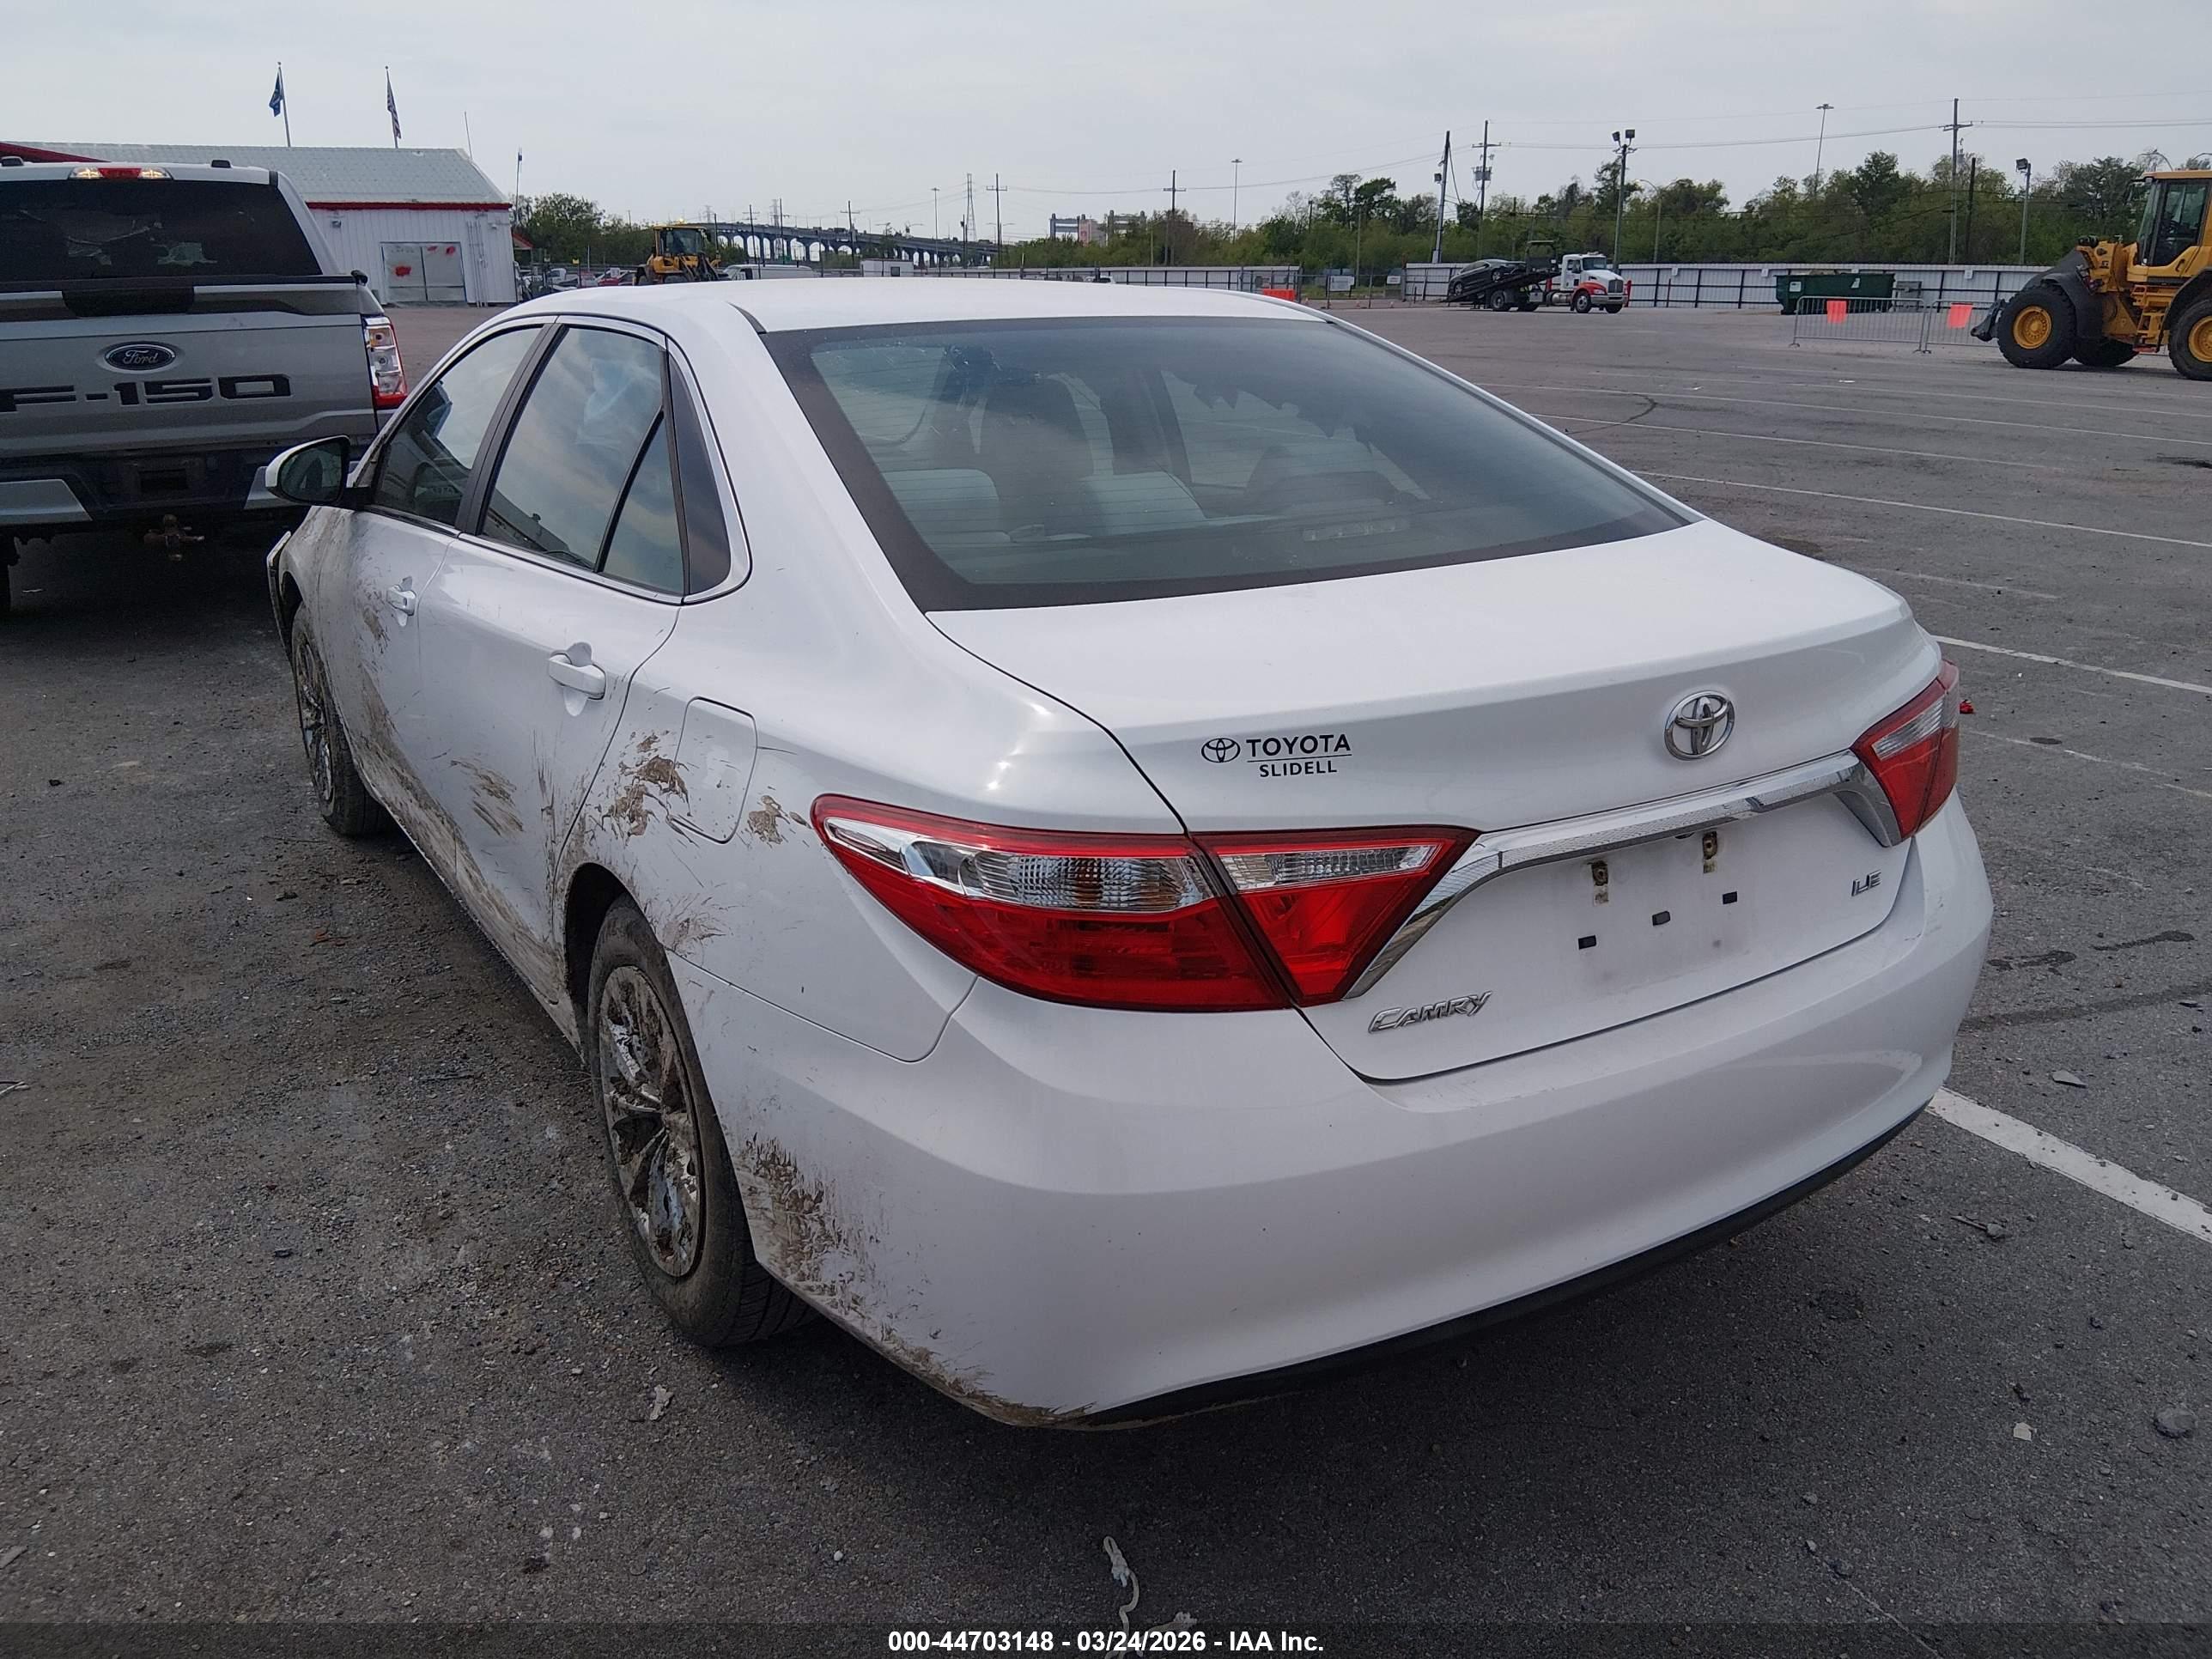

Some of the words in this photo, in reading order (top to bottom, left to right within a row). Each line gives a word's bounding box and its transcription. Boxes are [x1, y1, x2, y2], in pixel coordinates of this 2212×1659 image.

[123, 349, 158, 364] Ford
[0, 374, 292, 413] F-150
[1246, 734, 1351, 757] TOYOTA
[1259, 760, 1337, 778] SLIDELL
[1850, 868, 1882, 896] LE
[1367, 990, 1492, 1034] CAMRY
